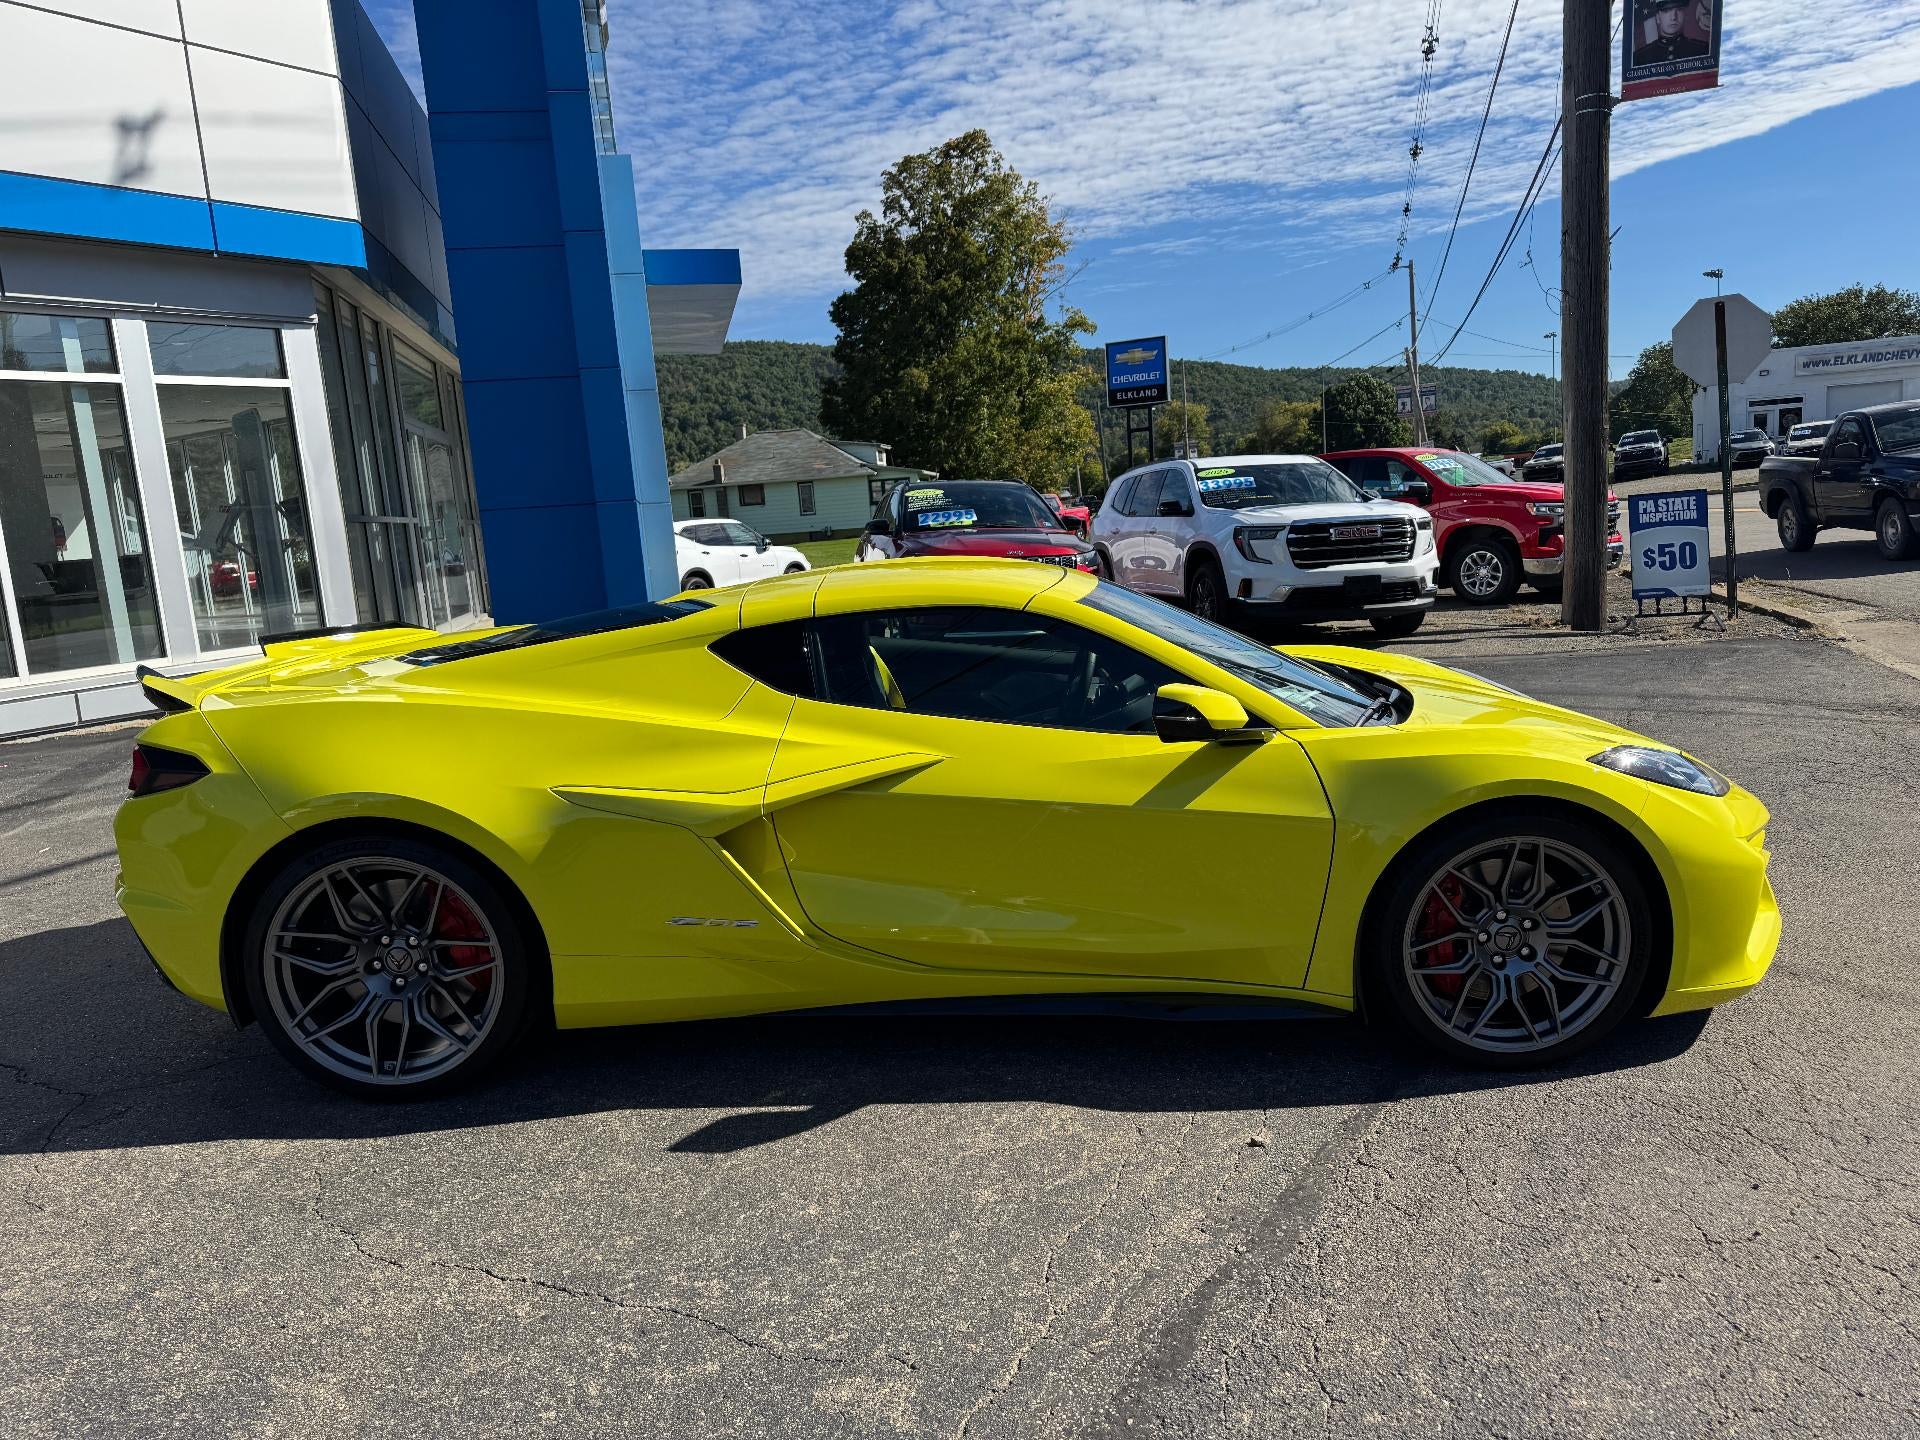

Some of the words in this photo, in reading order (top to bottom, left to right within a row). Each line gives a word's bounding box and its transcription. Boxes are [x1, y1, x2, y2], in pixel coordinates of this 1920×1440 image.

[1651, 65, 1665, 74] WAR
[1112, 371, 1160, 384] CHEVROLET
[1116, 388, 1158, 400] ELKLAND
[1199, 477, 1253, 491] 33995
[1638, 500, 1656, 513] PA
[1658, 496, 1697, 511] STATE
[919, 509, 974, 525] 22995
[1639, 509, 1698, 524] INSPECTION
[1336, 526, 1378, 539] GMC
[1642, 541, 1698, 571] $50
